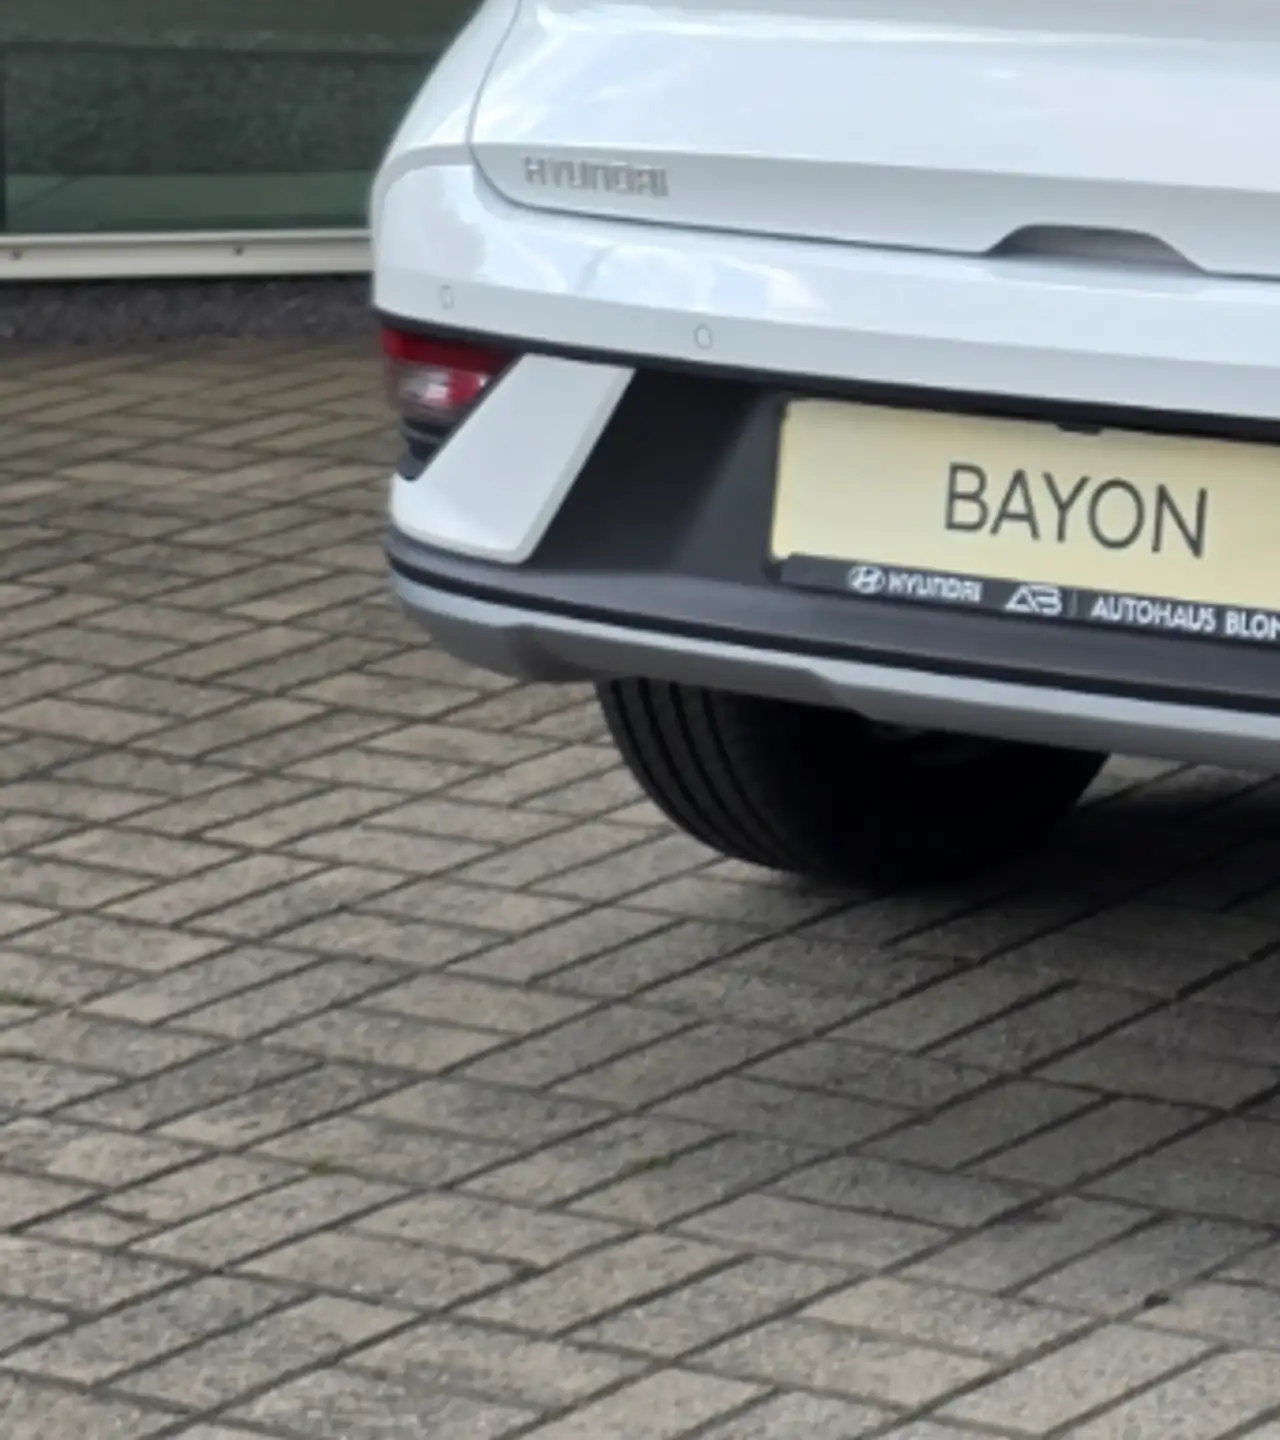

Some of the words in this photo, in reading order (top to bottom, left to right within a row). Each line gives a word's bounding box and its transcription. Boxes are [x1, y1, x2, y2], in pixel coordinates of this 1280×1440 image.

[523, 155, 669, 198] HYUNDAI
[943, 461, 1208, 559] BAYON
[886, 570, 983, 603] HYUNDAI
[1090, 595, 1217, 634] AUTOHAUS
